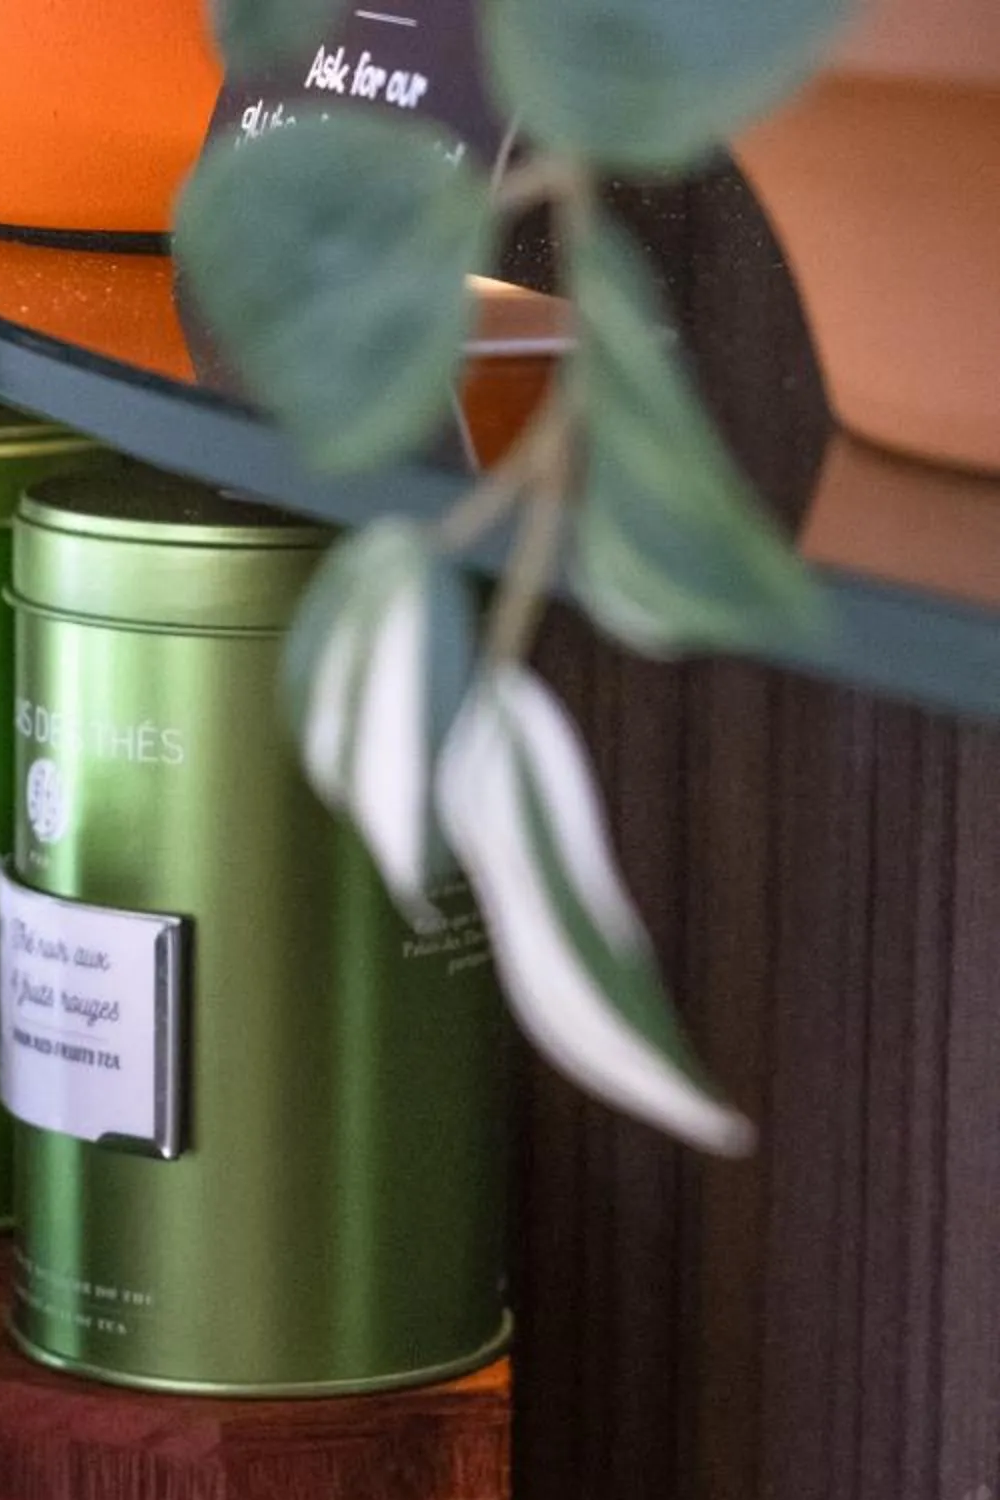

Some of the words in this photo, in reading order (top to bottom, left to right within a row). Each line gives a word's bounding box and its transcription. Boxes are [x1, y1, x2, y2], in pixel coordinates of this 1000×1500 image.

[304, 44, 349, 94] Ask
[350, 50, 387, 100] for
[386, 70, 429, 109] our
[90, 718, 184, 765] THÉS
[61, 990, 120, 1027] rouges
